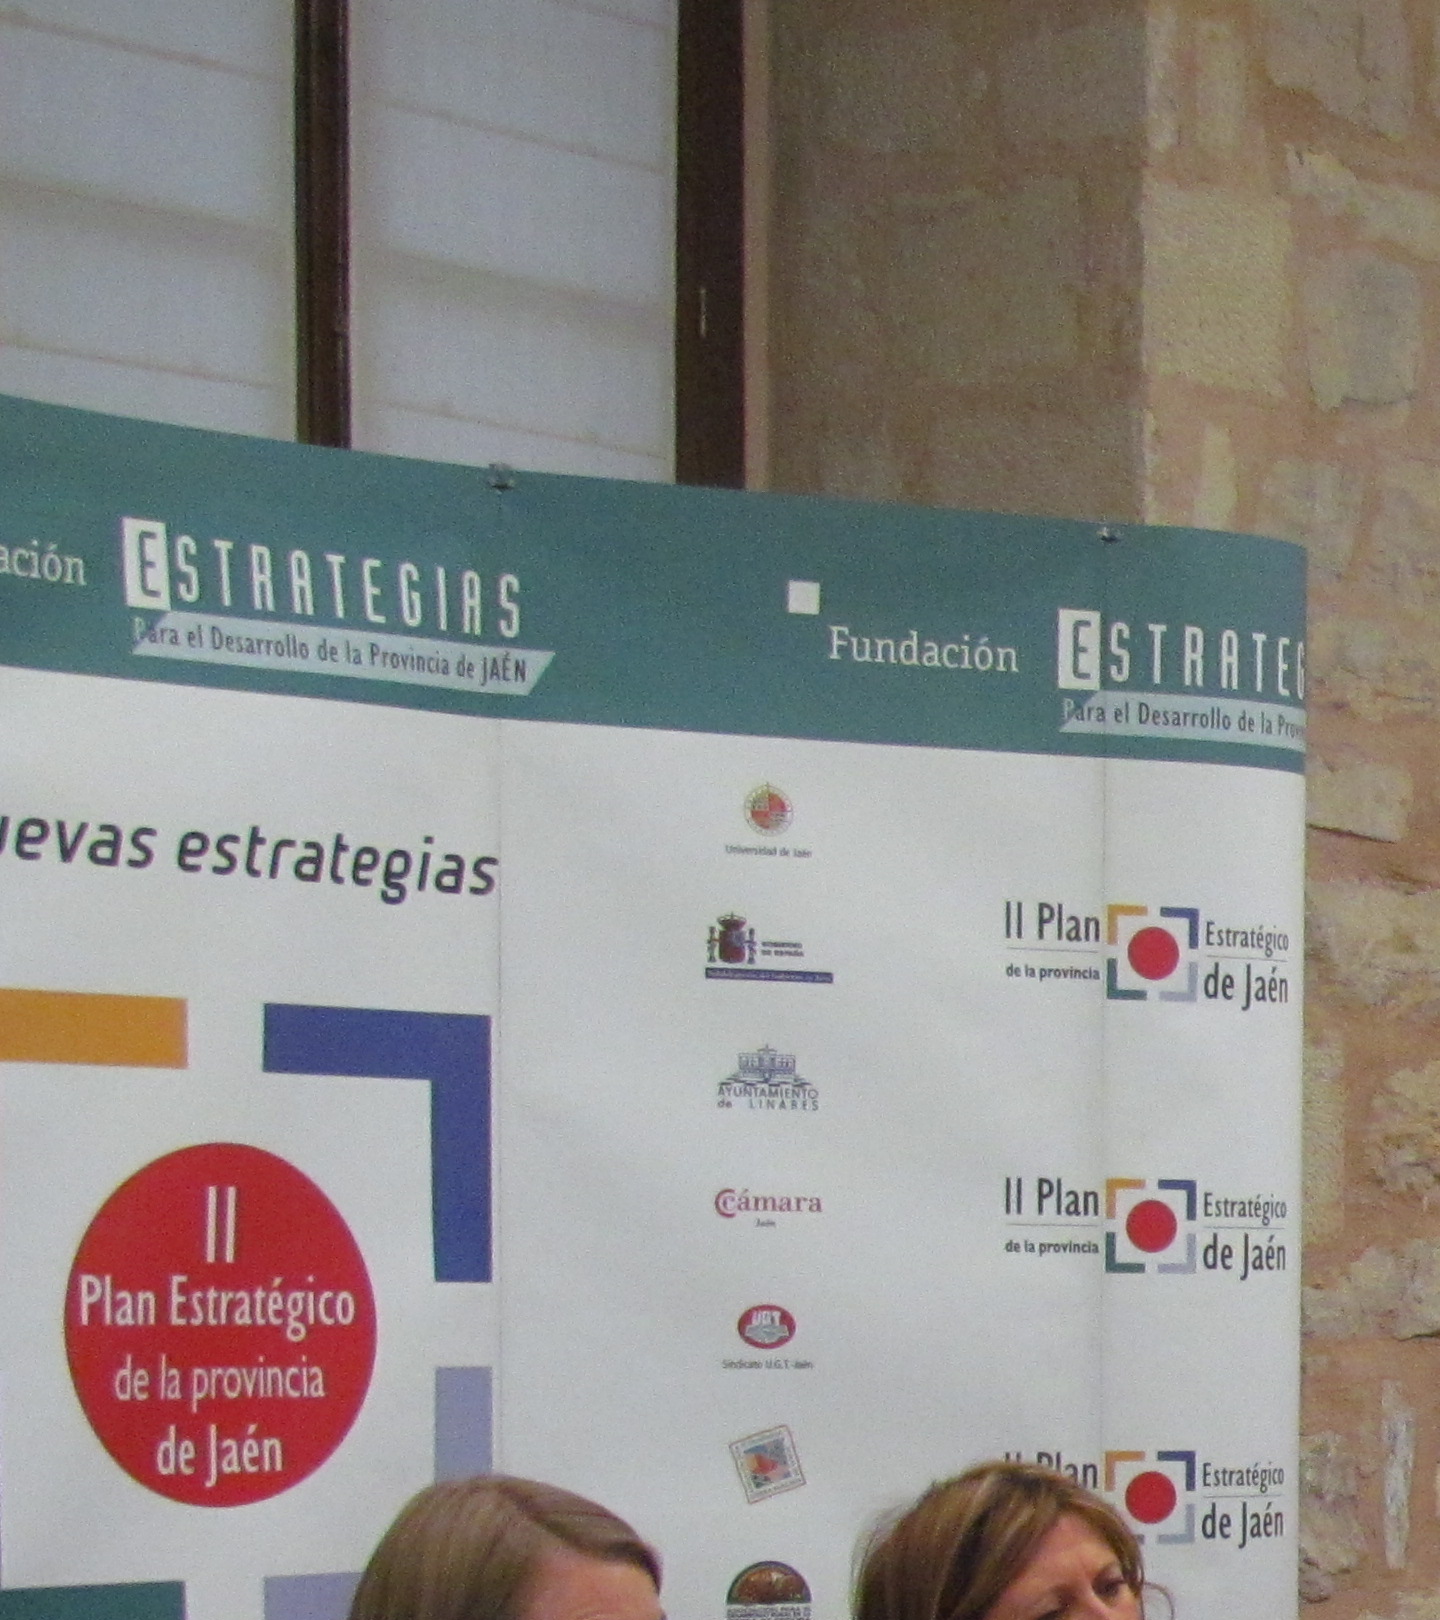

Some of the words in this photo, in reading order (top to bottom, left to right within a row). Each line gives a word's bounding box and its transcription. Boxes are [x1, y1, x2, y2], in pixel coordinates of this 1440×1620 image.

[124, 518, 520, 638] ESTRATEGIAS
[132, 616, 181, 646] Para
[188, 625, 203, 648] el
[211, 625, 310, 661] Desarrollo
[317, 638, 338, 663] de
[346, 640, 363, 665] la
[370, 642, 450, 676] Provincia
[456, 653, 475, 679] de
[481, 650, 527, 686] JAÉN
[828, 625, 1019, 673] Fundación
[1063, 698, 1106, 723] Para
[1113, 701, 1129, 724] el
[1138, 702, 1231, 730] Desarrollo
[1238, 709, 1255, 732] de
[1261, 711, 1272, 735] la
[176, 824, 500, 905] estrategias
[1005, 900, 1023, 940] II
[1037, 902, 1100, 942] Plan
[1205, 919, 1290, 957] Estratégico
[1006, 963, 1021, 978] de
[1025, 964, 1036, 978] la
[1039, 965, 1100, 982] provincia
[1204, 961, 1235, 1000] de
[1241, 962, 1290, 1011] Jaén
[717, 1085, 819, 1100] AYUNTAMIENTO
[717, 1100, 732, 1109] de
[749, 1100, 819, 1112] LINARES
[1005, 1176, 1023, 1215] II
[1037, 1177, 1099, 1217] Plan
[1203, 1192, 1288, 1226] Estratégico
[205, 1185, 237, 1264] II
[1005, 1240, 1020, 1253] de
[1024, 1239, 1035, 1253] la
[1038, 1239, 1100, 1256] provincia
[1202, 1232, 1234, 1271] de
[1239, 1232, 1287, 1281] Jaén
[79, 1273, 156, 1326] Plan
[169, 1274, 355, 1342] Estratégico
[114, 1353, 149, 1401] de
[160, 1353, 182, 1400] la
[192, 1355, 326, 1414] provincia
[156, 1424, 196, 1476] de
[204, 1423, 284, 1488] Jaén
[1202, 1462, 1285, 1494] Estratégico
[1202, 1501, 1232, 1540] de
[1238, 1500, 1284, 1549] Jaén
